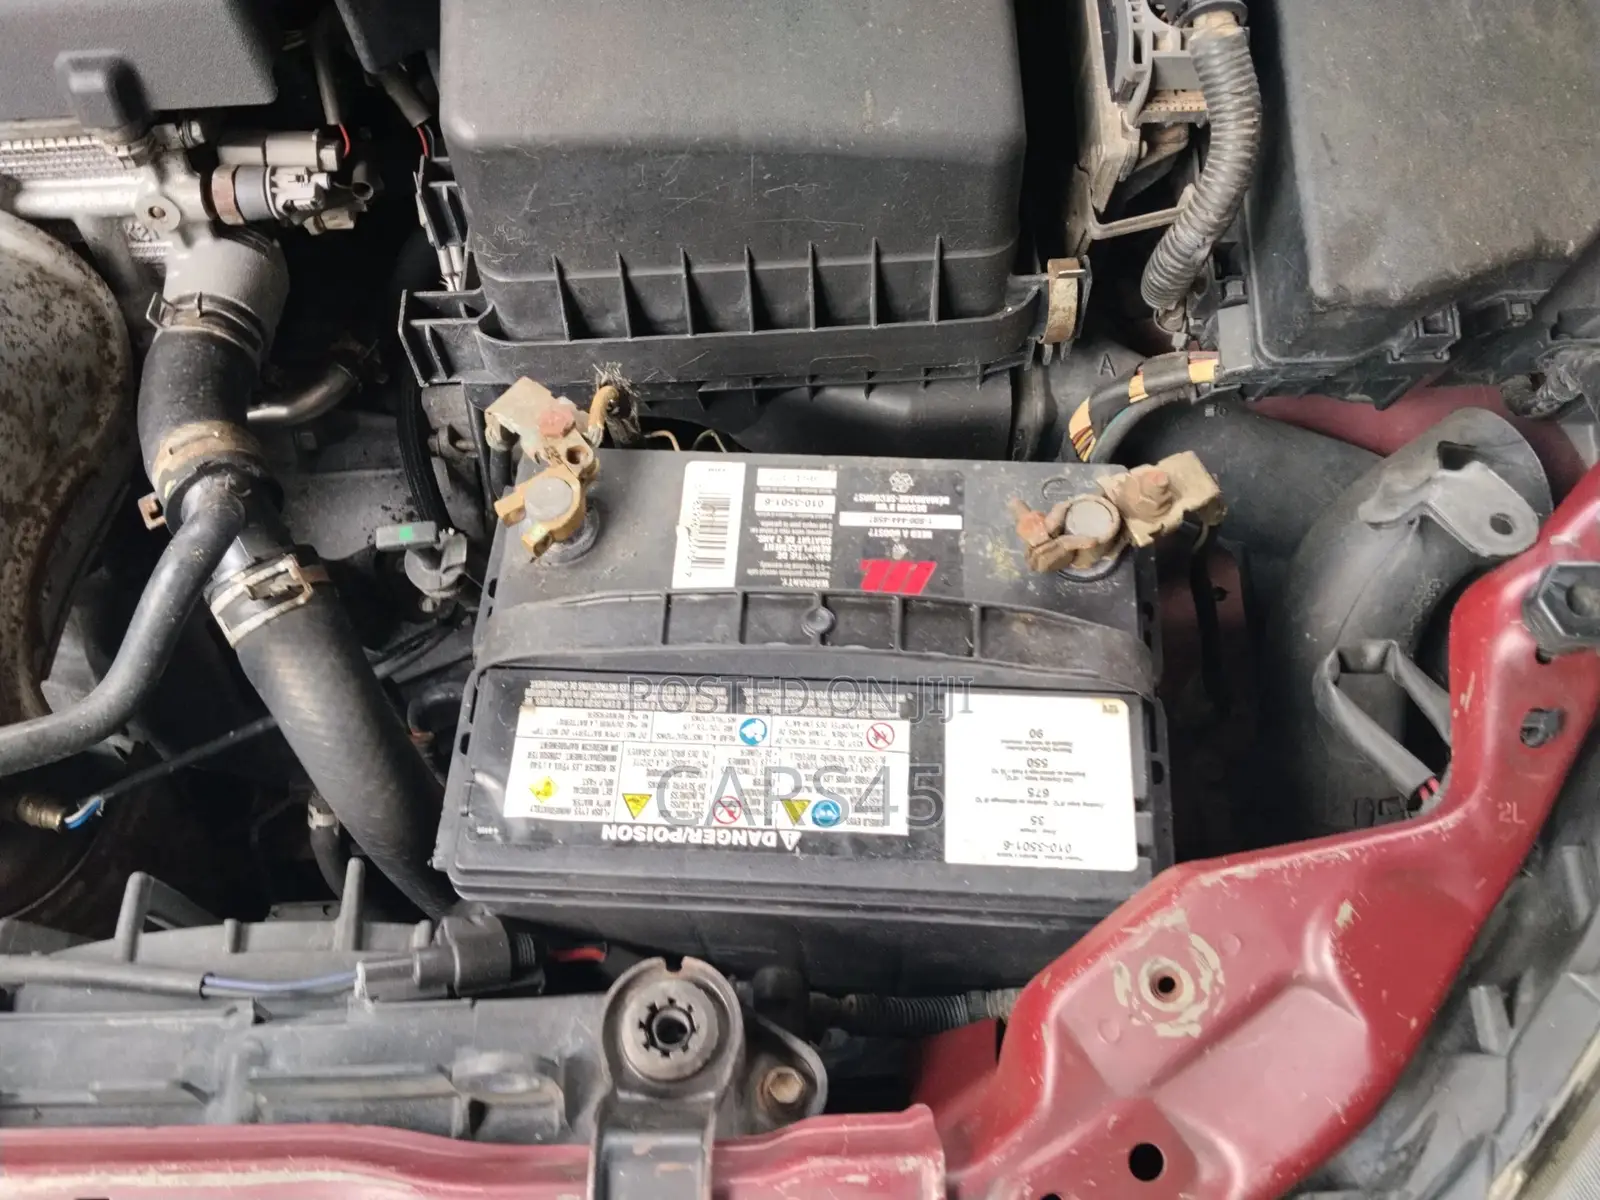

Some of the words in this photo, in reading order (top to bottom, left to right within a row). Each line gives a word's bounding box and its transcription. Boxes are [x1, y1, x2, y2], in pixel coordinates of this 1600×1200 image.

[1098, 353, 1116, 377] A
[1029, 729, 1044, 739] 90
[1027, 758, 1048, 768] 550
[1027, 787, 1049, 798] 675
[1030, 815, 1044, 826] 35
[601, 824, 777, 847] DANGER/POISON
[1003, 841, 1072, 854] 010-3501-6
